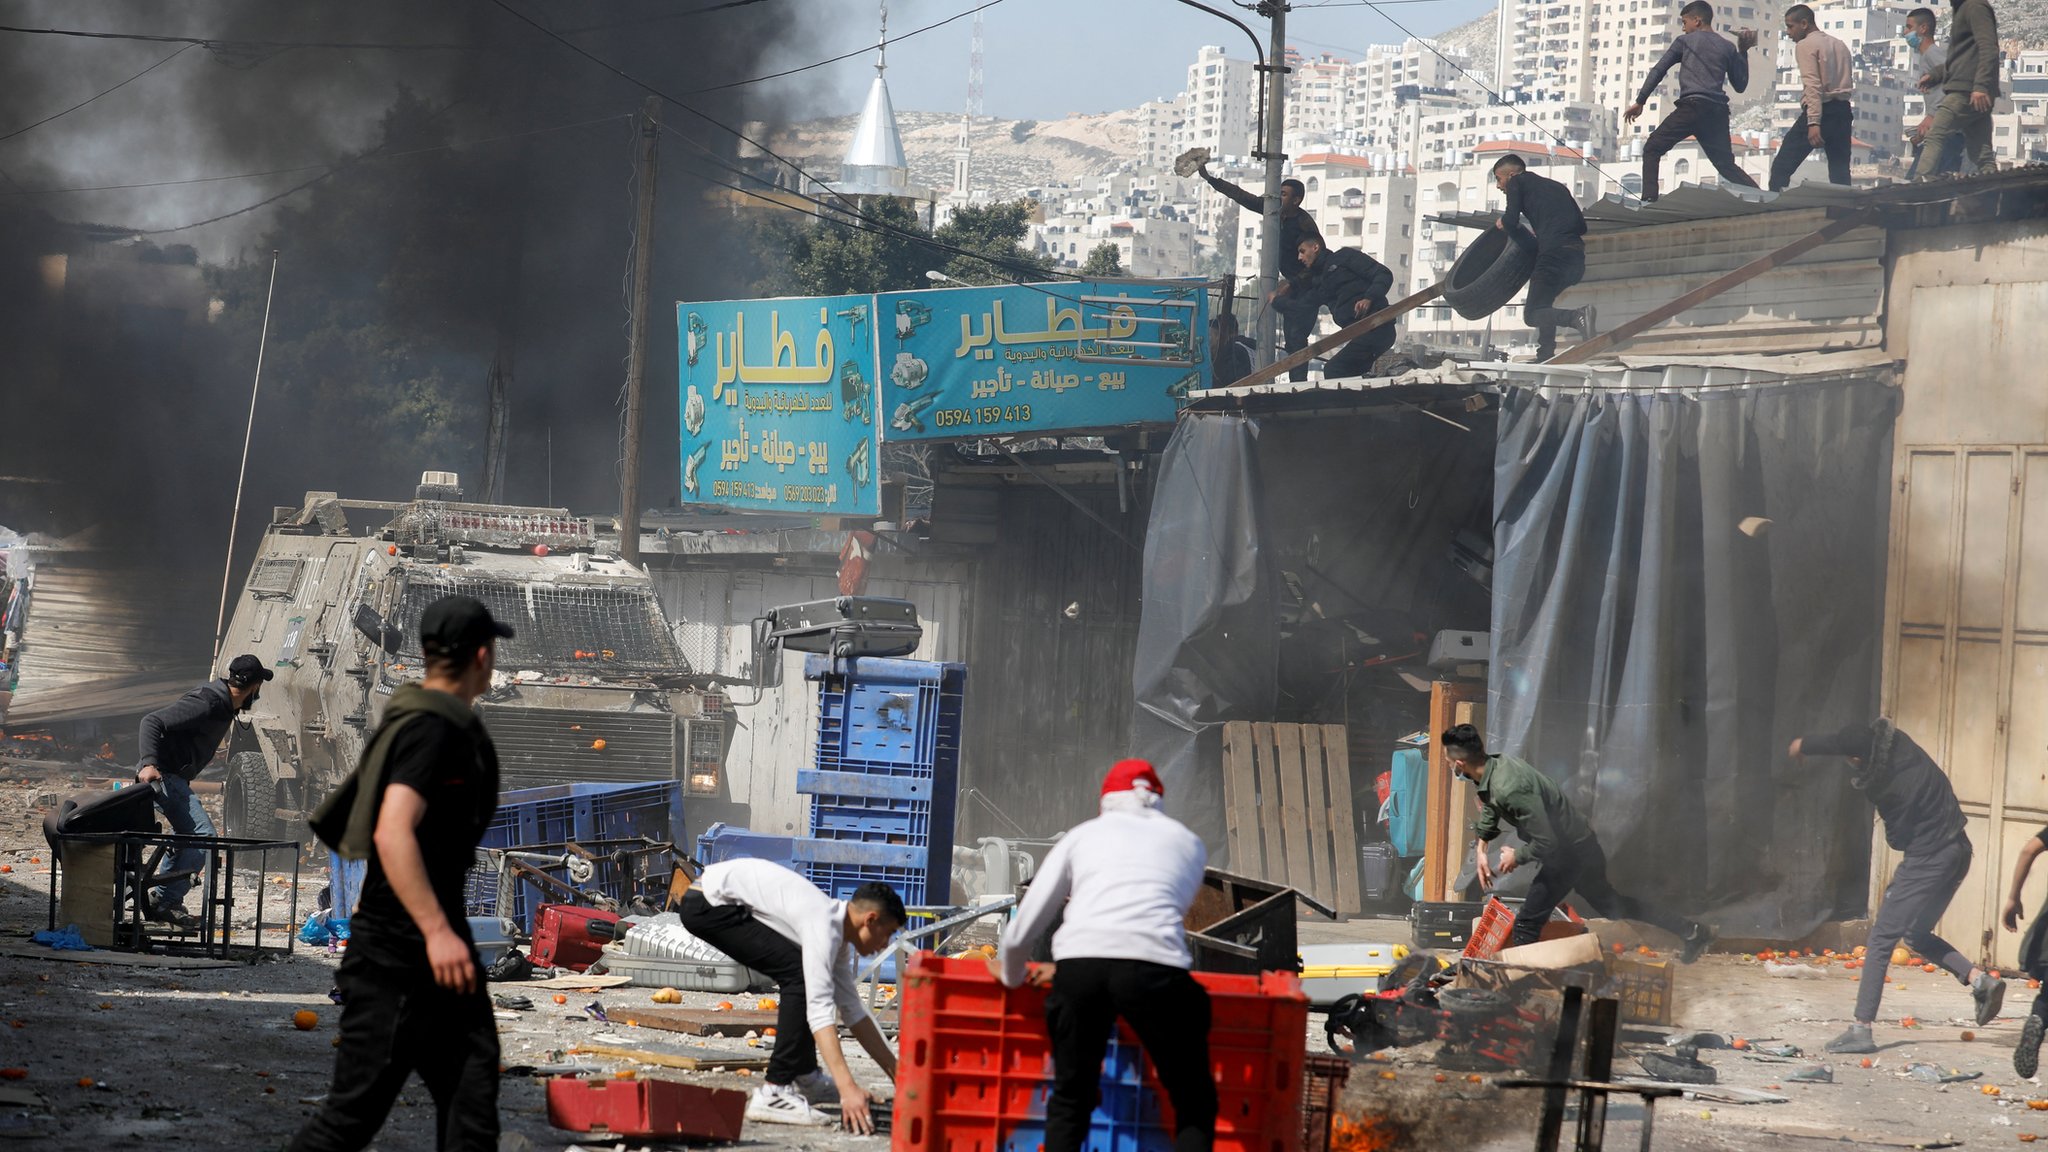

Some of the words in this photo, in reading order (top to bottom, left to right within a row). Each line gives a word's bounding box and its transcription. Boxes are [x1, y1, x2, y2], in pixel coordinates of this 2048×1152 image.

[955, 293, 1137, 360] فطاير
[712, 307, 834, 406] فطاير
[1005, 348, 1047, 364] واليدوية
[1104, 343, 1136, 355] للعد
[971, 366, 1012, 399] تأجير
[1031, 369, 1080, 394] صيانة
[1098, 371, 1126, 391] بيع
[744, 389, 773, 417] واليدوية
[811, 391, 833, 411] للعدد
[935, 408, 972, 427] 0594
[975, 405, 1002, 424] 159
[1004, 404, 1031, 422] 413
[720, 416, 750, 471] تأجير
[761, 429, 797, 473] صيانة
[808, 440, 829, 475] بيع
[713, 479, 729, 498] 0594
[730, 479, 743, 498] 159
[742, 480, 755, 499] 413
